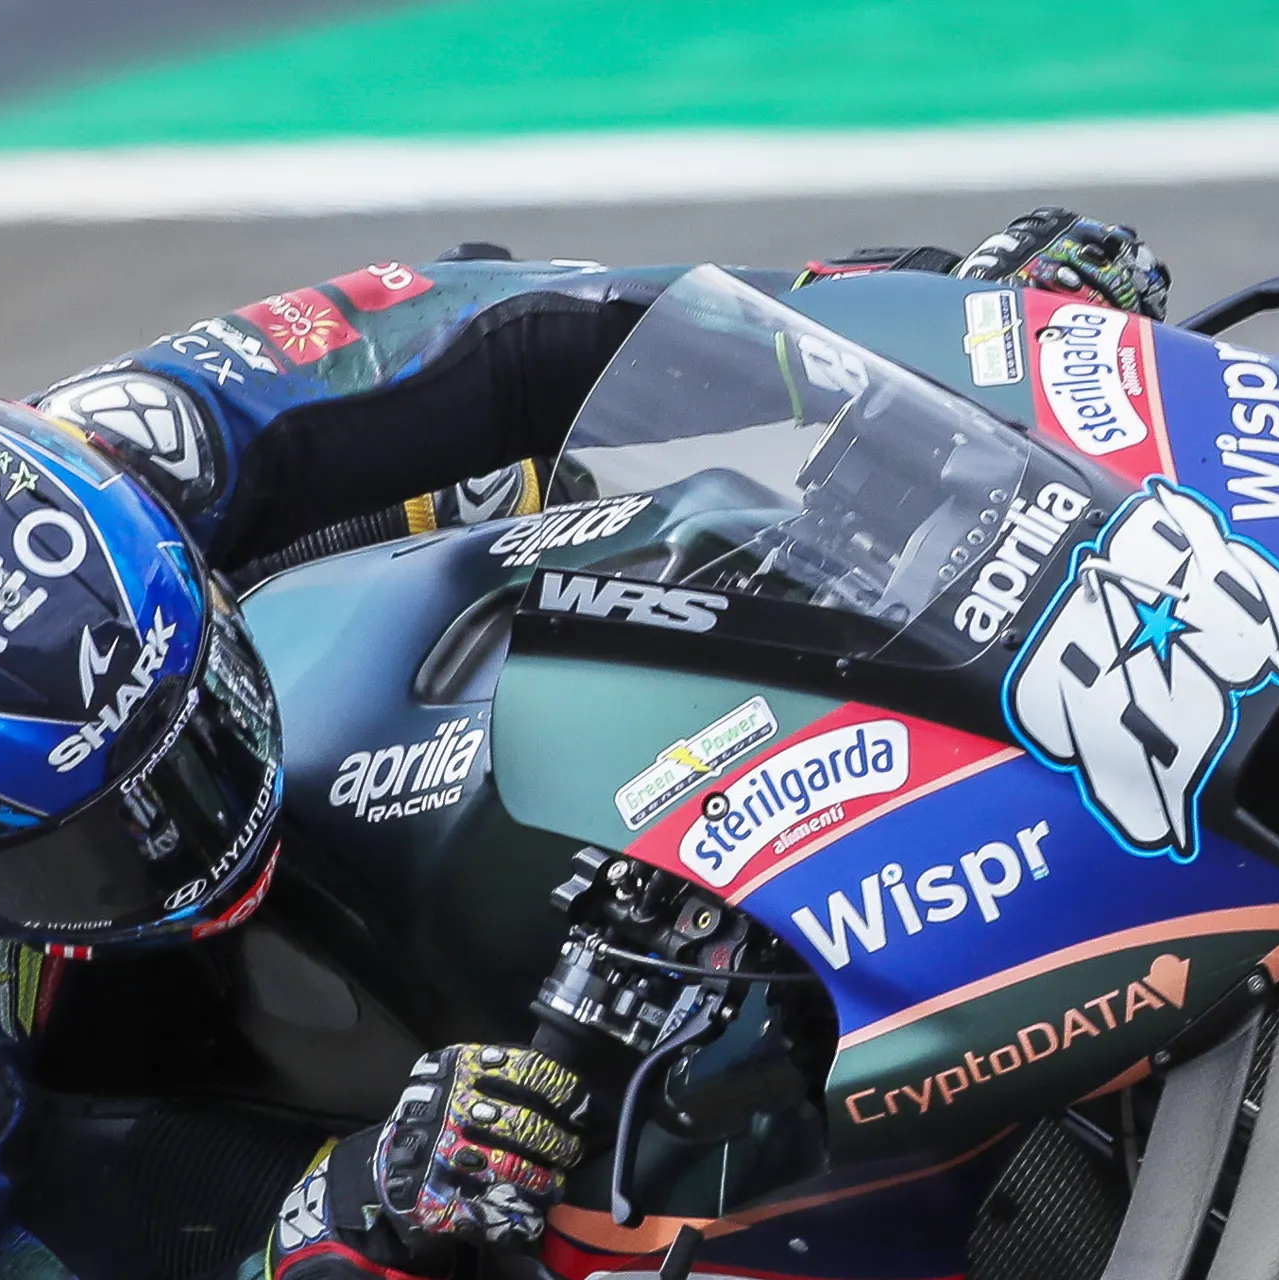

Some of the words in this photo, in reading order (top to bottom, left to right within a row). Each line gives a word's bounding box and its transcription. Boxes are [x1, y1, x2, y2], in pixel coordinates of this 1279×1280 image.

[1052, 313, 1127, 442] sterilgarda
[489, 495, 654, 568] aprilia
[953, 482, 1092, 643] aprilia
[538, 571, 730, 634] WRS
[48, 606, 177, 774] SHARK
[701, 713, 757, 757] Power
[210, 756, 278, 881] HYUNDAI
[329, 717, 486, 818] aprilia
[367, 784, 463, 822] RACING
[696, 729, 895, 871] sterilgarda
[772, 803, 845, 855] alimenti
[791, 820, 1051, 972] Wispr
[845, 978, 1166, 1126] CryptoDATA
